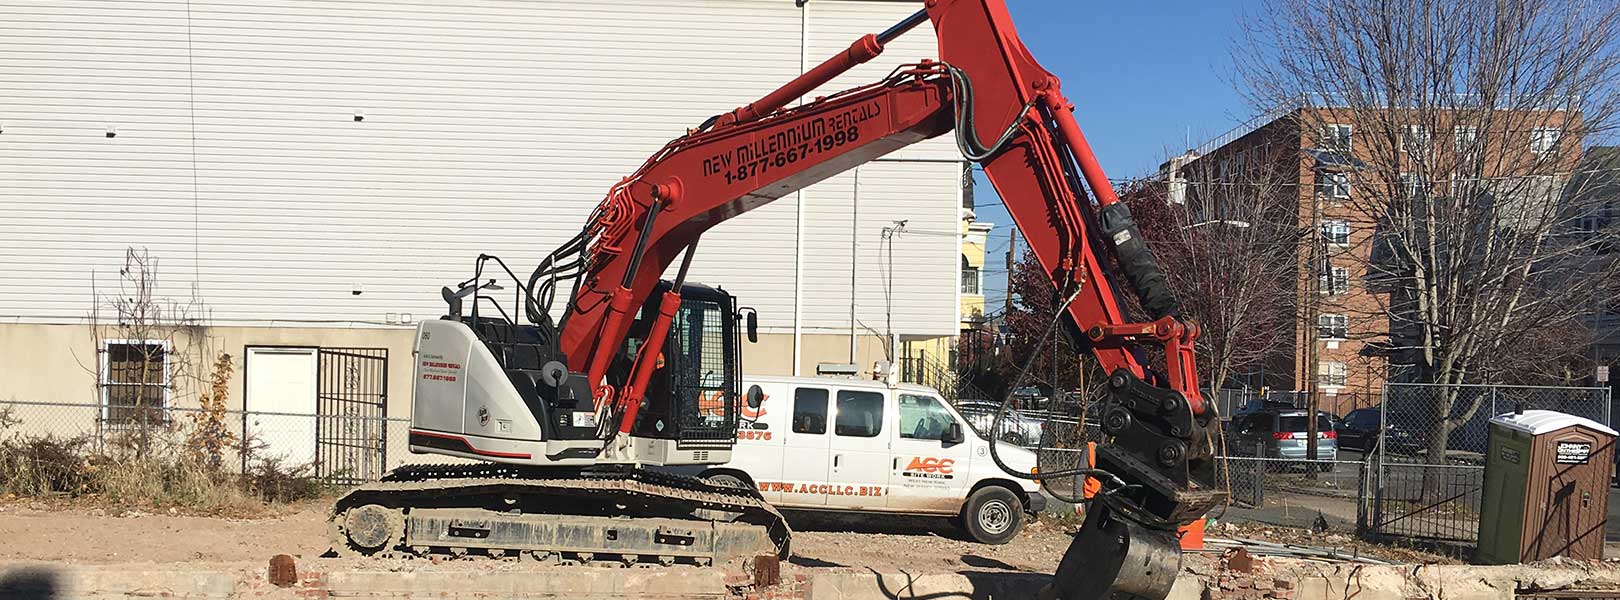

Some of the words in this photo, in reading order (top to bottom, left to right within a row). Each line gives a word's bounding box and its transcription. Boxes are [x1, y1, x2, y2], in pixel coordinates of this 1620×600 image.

[703, 151, 733, 176] NEW
[829, 101, 881, 132] RENTALS
[724, 126, 859, 185] 1-877-667-1998
[905, 457, 955, 473] ACC
[758, 482, 882, 496] WWW.ACCLLC.BIZ
